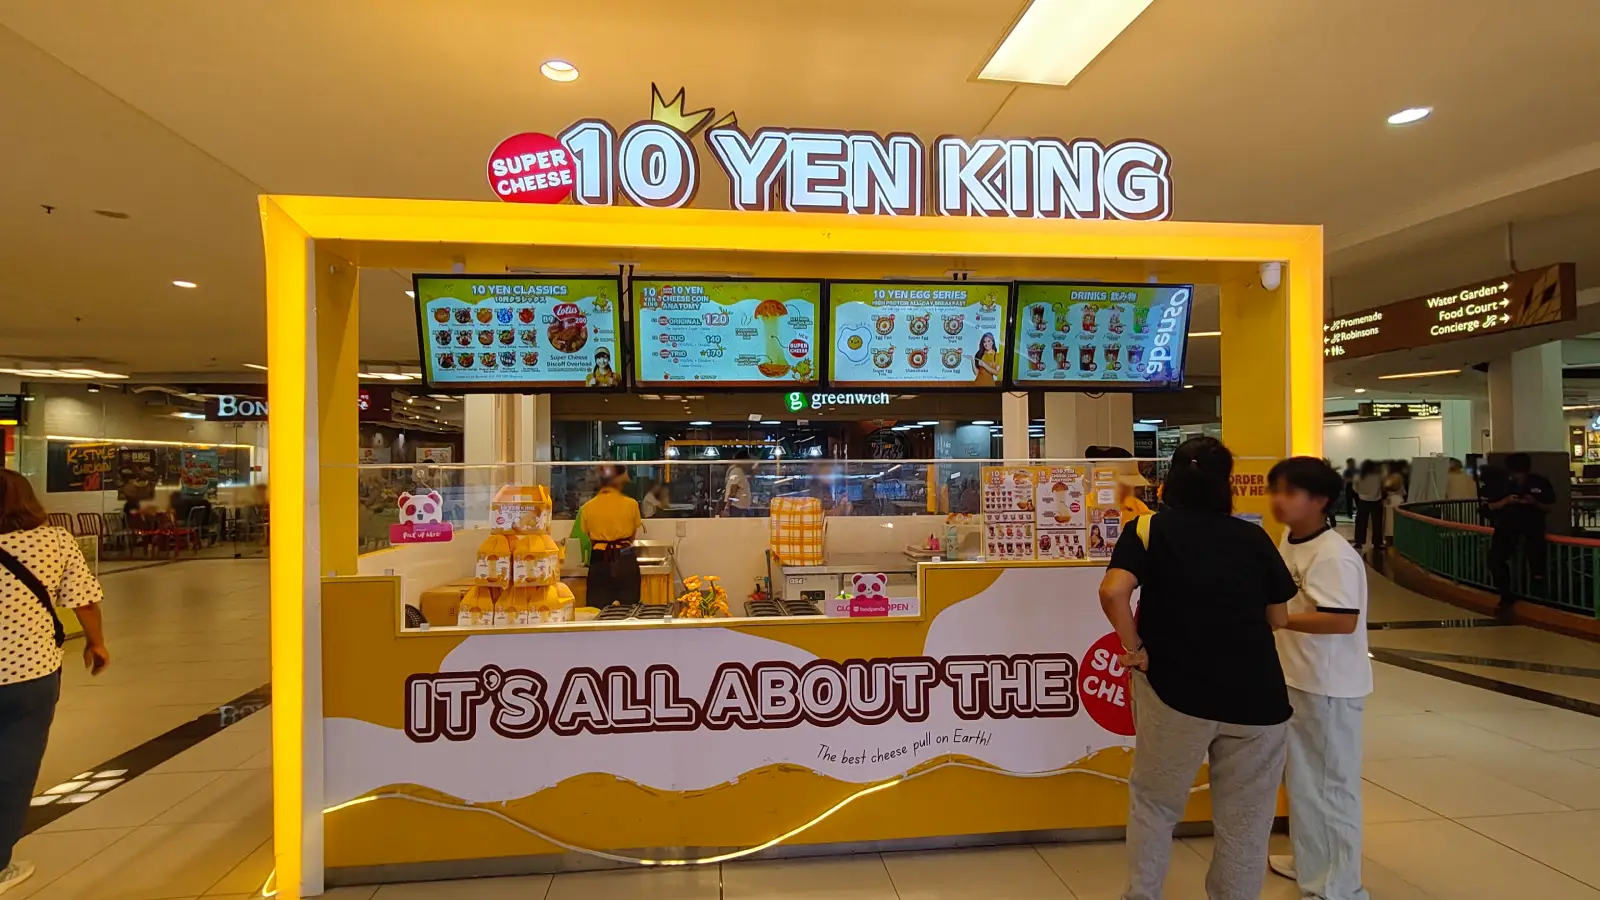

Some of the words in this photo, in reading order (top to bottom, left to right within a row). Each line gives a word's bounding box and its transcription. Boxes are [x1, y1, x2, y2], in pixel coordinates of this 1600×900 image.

[492, 149, 568, 177] SUPER
[558, 120, 698, 209] 10
[706, 127, 923, 216] YEN
[935, 136, 1172, 220] KING
[497, 169, 573, 196] CHEESE
[471, 285, 485, 295] 10
[487, 285, 511, 295] YEN
[514, 285, 568, 295] CLASSICS
[672, 286, 683, 294] 10
[684, 286, 704, 294] YEN
[874, 290, 885, 299] 10
[888, 290, 908, 299] YEN
[910, 290, 931, 299] EGG
[933, 290, 967, 299] SERIES
[1070, 291, 1108, 300] DRINKS
[1427, 294, 1458, 309] Water
[1459, 284, 1498, 302] Garden
[557, 305, 577, 316] Lotus
[1340, 311, 1383, 328] Promenade
[1438, 308, 1465, 322] Food
[1465, 301, 1499, 317] Court
[1340, 325, 1379, 341] Robinsons
[1430, 318, 1480, 337] Concierge
[706, 349, 723, 357] 170
[811, 392, 890, 410] greenwich
[550, 664, 700, 736] ALL
[705, 657, 939, 730] ABOUT
[941, 653, 1078, 720] THE
[817, 744, 838, 763] The
[841, 749, 866, 765] best
[871, 745, 908, 764] cheese
[912, 731, 932, 758] pull
[936, 734, 949, 745] on
[953, 728, 992, 746] Earth!
